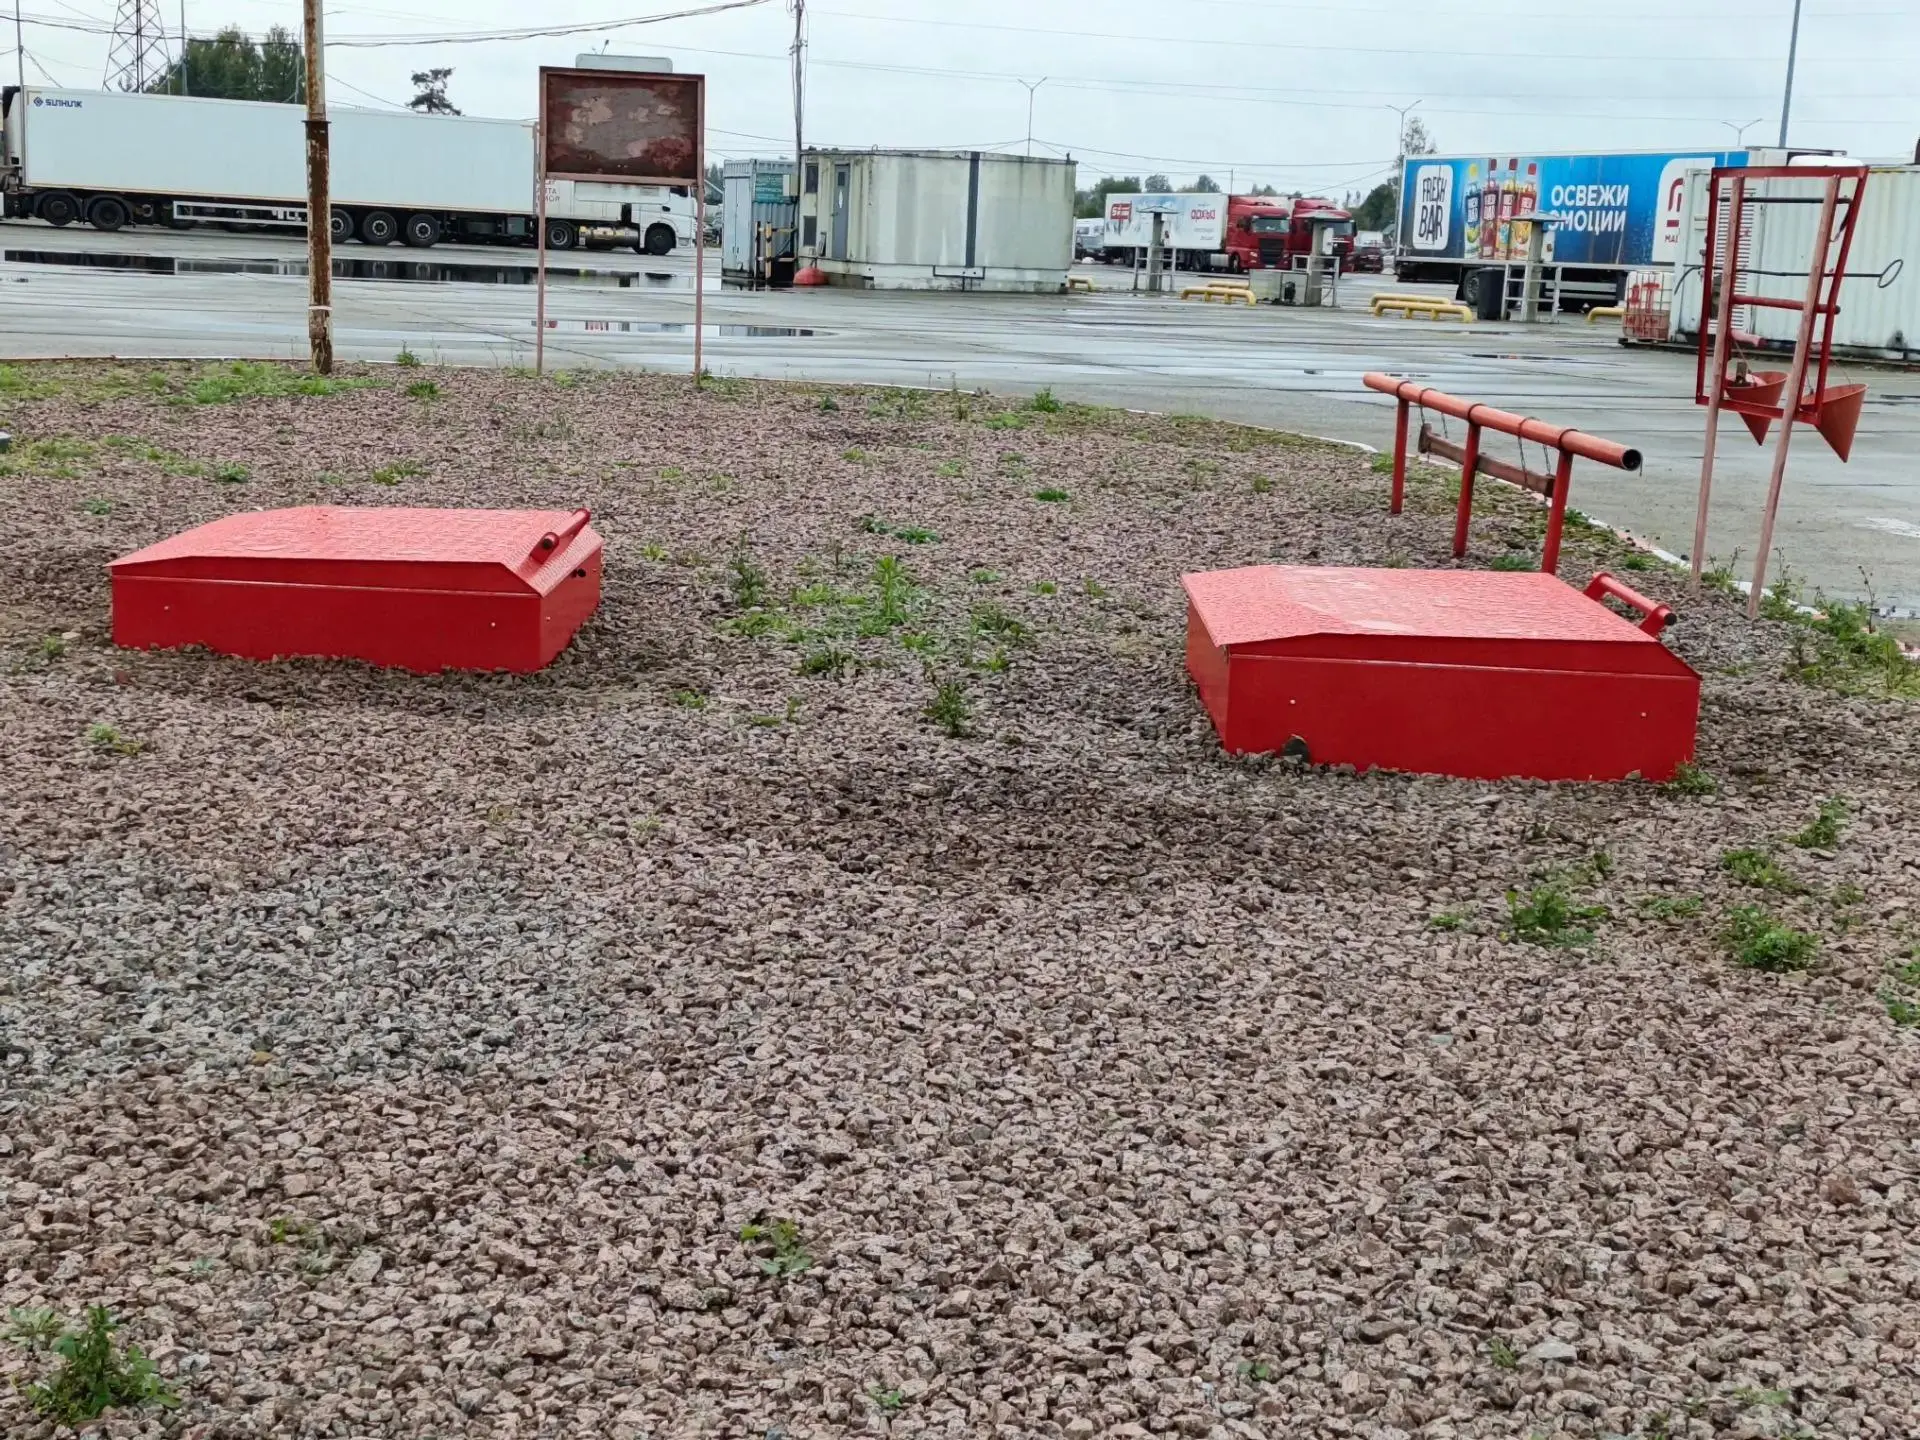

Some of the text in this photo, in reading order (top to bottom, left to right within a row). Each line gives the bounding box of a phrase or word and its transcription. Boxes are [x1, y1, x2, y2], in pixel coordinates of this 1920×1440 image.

[1422, 175, 1448, 202] FRESH
[1550, 184, 1630, 207] ОСВЕЖИ
[1418, 204, 1444, 241] BAR
